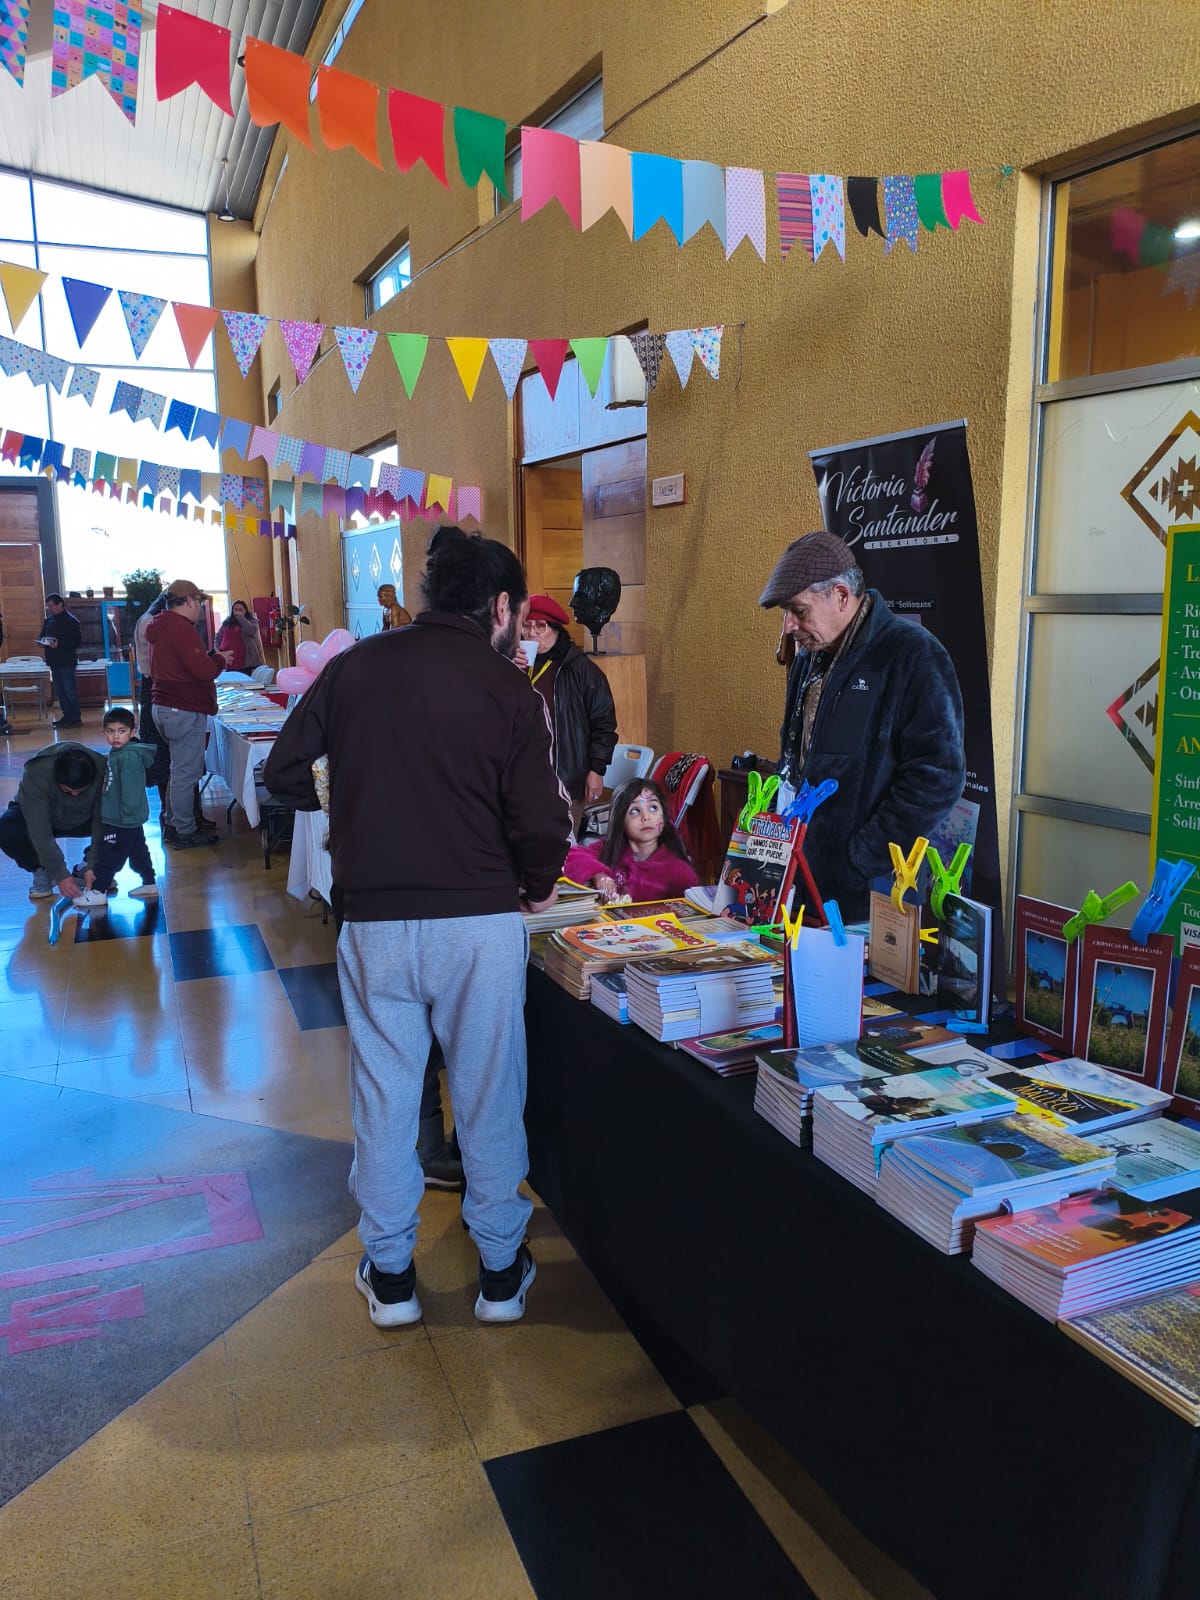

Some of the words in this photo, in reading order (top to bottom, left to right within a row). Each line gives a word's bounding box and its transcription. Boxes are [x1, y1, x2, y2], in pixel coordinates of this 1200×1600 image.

[825, 465, 907, 512] Victoria
[841, 499, 958, 546] Santander
[871, 536, 950, 549] ESCRITORA
[1186, 564, 1200, 582] L
[1185, 604, 1200, 617] Ri
